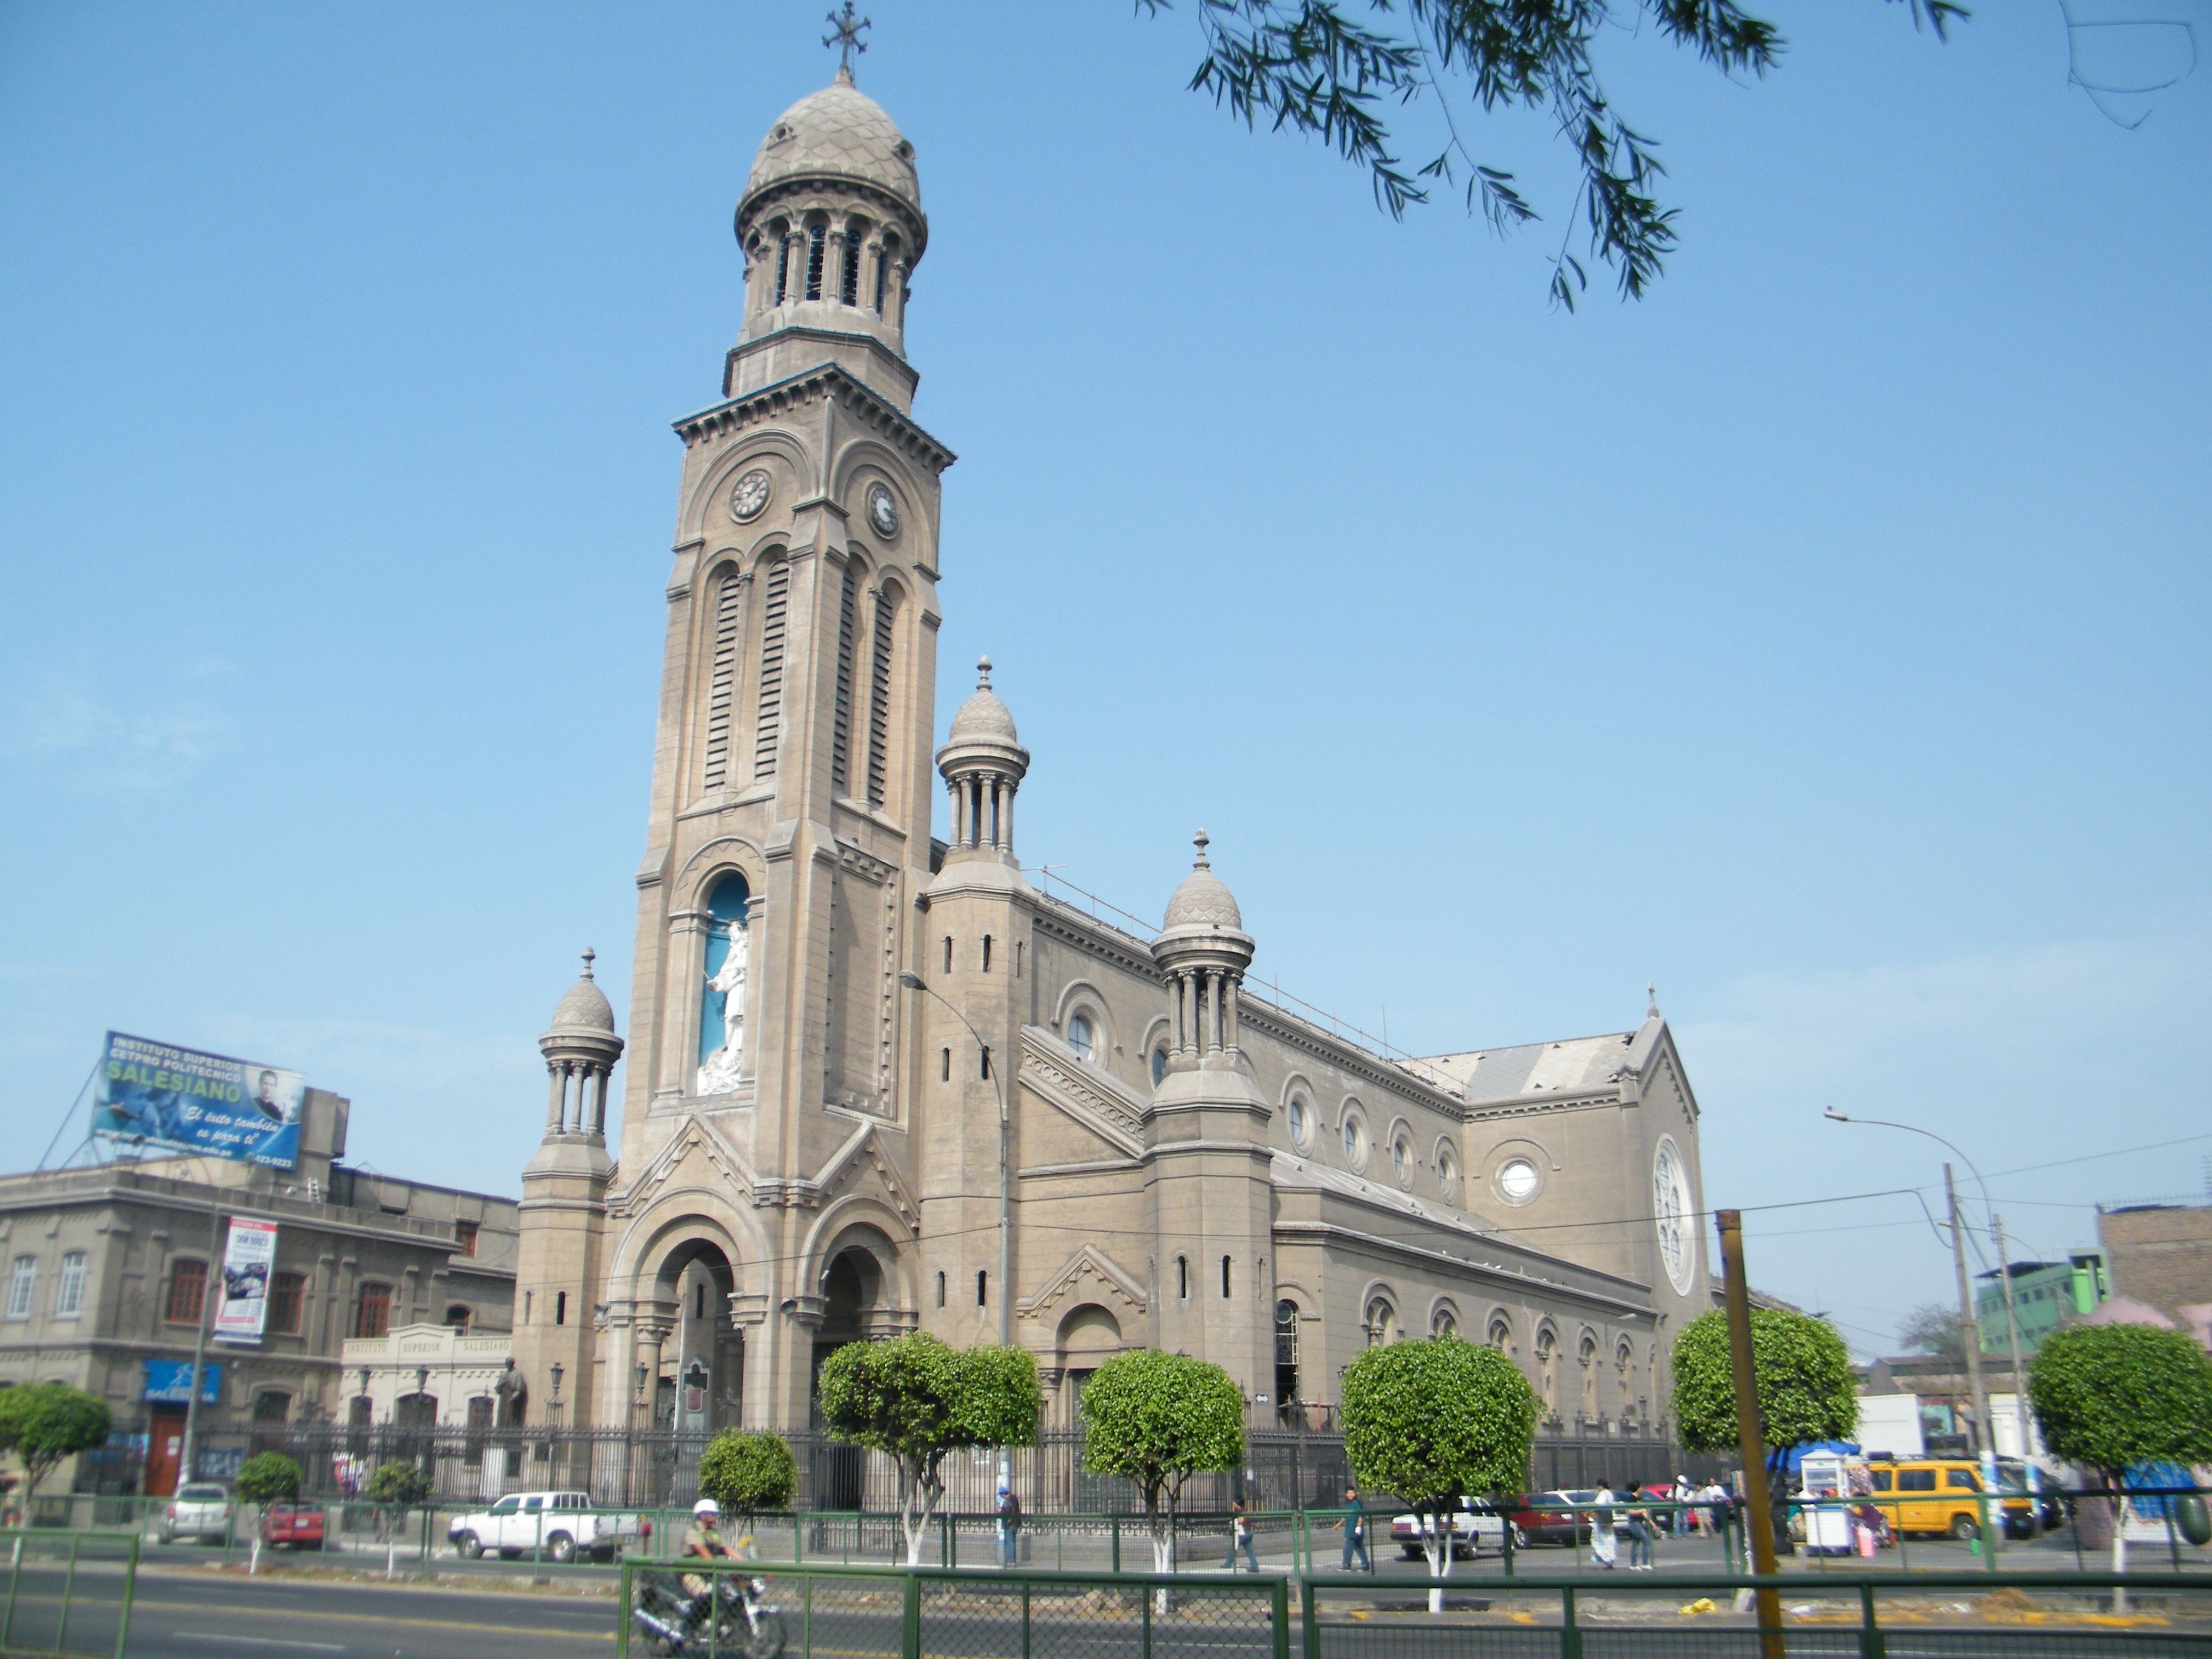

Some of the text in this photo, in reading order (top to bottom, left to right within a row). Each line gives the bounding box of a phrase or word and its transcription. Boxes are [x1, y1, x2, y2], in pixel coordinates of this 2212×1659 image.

[110, 1048, 240, 1084] CETPRO POLITECNICO
[113, 1037, 241, 1072] INSTITUTO SUPERIOR
[107, 1060, 241, 1103] SALESIANO
[196, 1128, 209, 1138] es
[210, 1130, 241, 1144] para
[346, 1341, 508, 1353] INSTITUTO SUPERIOR SALESIANO
